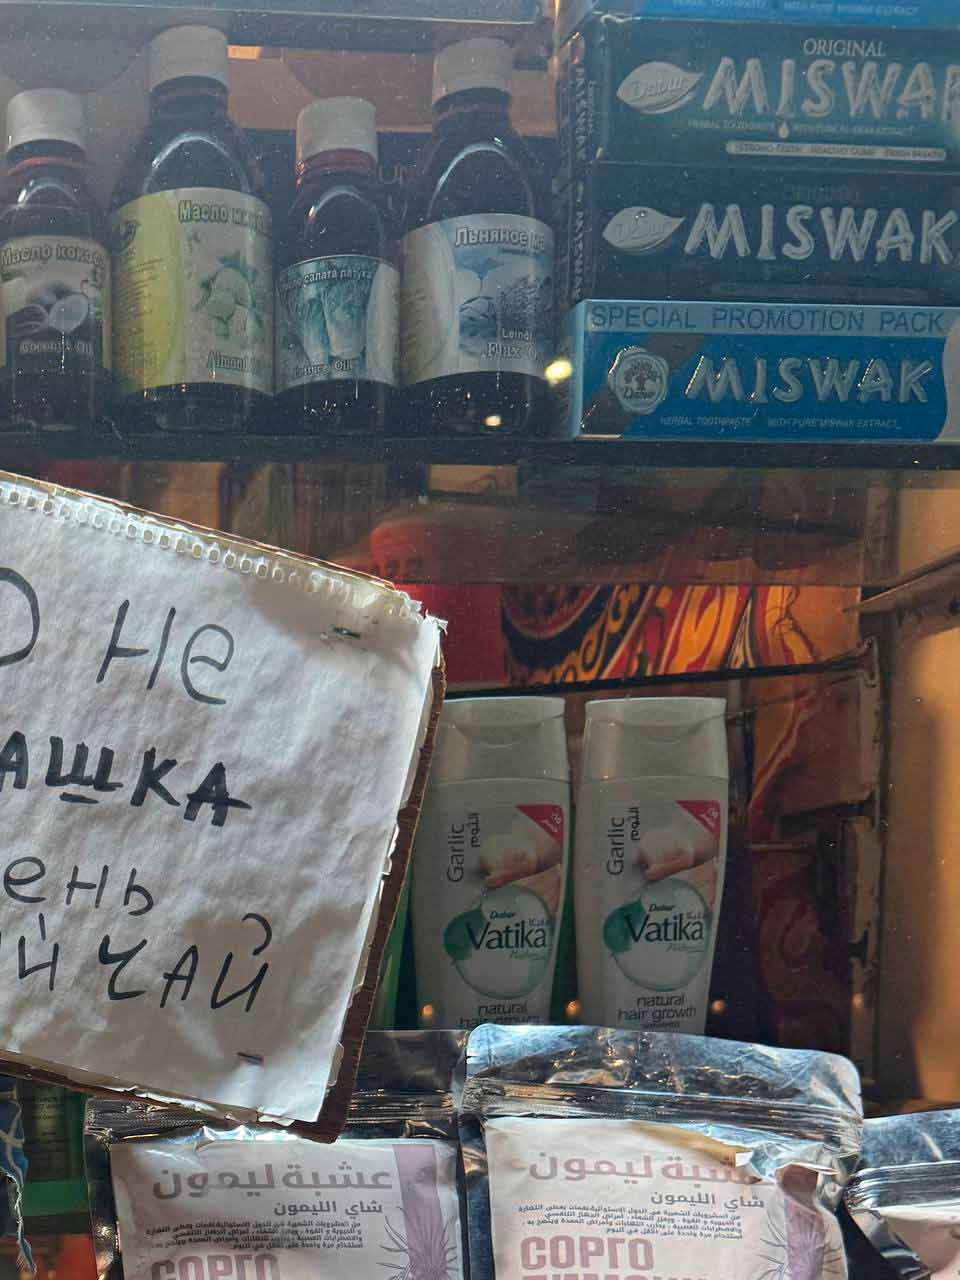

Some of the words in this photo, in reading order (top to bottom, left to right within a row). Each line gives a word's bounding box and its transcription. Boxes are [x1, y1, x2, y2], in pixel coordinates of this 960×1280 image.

[803, 38, 887, 58] ORIGINAL
[178, 201, 227, 224] Масло
[455, 226, 528, 247] Льняное
[683, 203, 958, 265] MISWAK
[0, 246, 52, 265] Масло
[590, 305, 696, 330] SPECIAL
[712, 308, 864, 332] PROMOTION
[881, 311, 944, 333] PACK
[685, 356, 936, 404] MISWAK
[447, 823, 465, 882] Garlic
[607, 817, 625, 876] Garlic
[466, 919, 547, 950] Vatika
[624, 913, 705, 943] Vatika
[98, 911, 273, 1013] ЧАЙ
[477, 1000, 528, 1016] natural
[636, 993, 685, 1008] natural
[617, 1007, 645, 1021] hair
[651, 1007, 697, 1024] growth
[151, 1163, 275, 1200] ليمون
[281, 1160, 393, 1197] عشبة
[528, 1154, 652, 1183] ليمون
[660, 1152, 756, 1188] شبة
[273, 1200, 338, 1216] الليمون
[344, 1200, 384, 1220] شاي
[650, 1191, 716, 1207] الليمون
[724, 1196, 765, 1214] شاي
[520, 1235, 655, 1271] СОРГО
